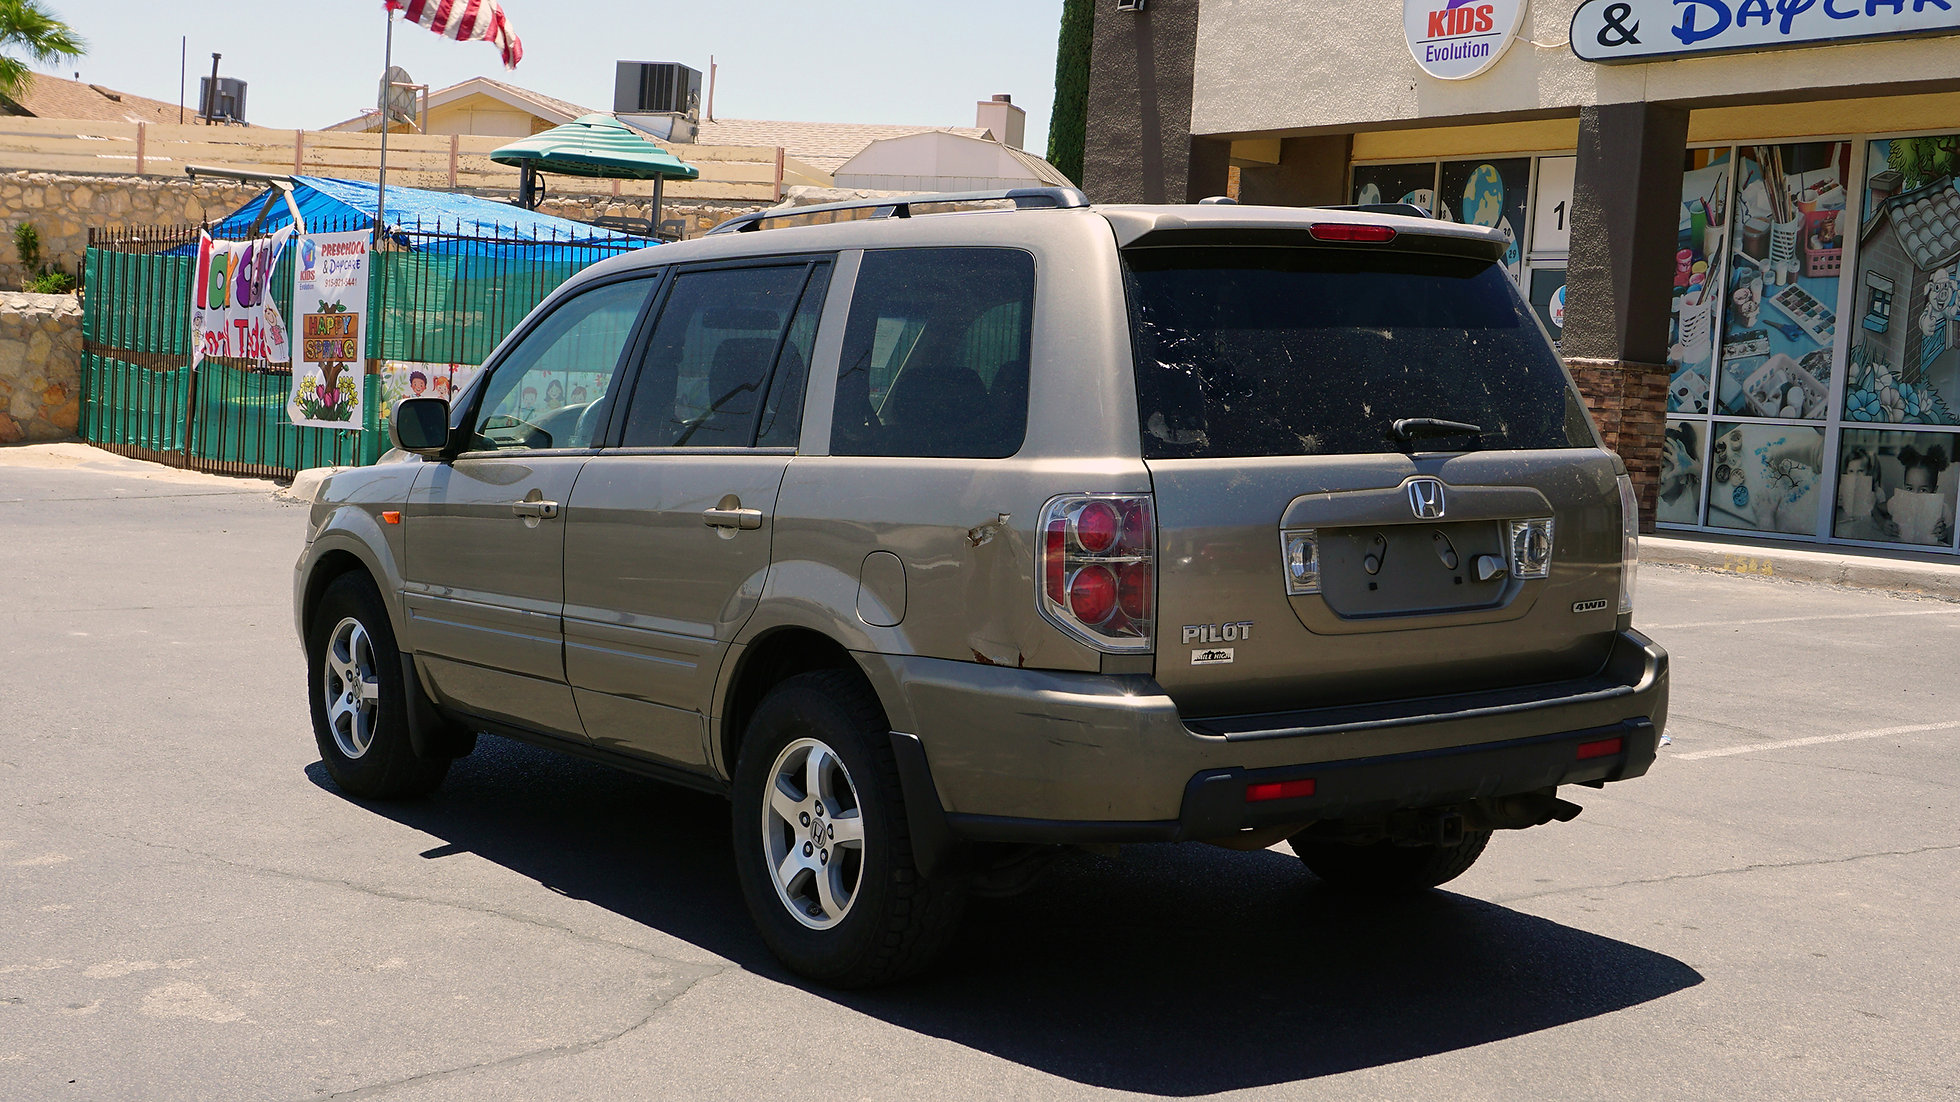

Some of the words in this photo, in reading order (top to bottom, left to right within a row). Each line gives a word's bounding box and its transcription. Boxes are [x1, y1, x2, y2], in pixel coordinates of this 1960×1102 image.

[1427, 4, 1494, 38] KIDS
[1597, 2, 1642, 47] &
[1425, 41, 1489, 62] Evolution
[1553, 200, 1571, 231] 1
[321, 241, 365, 257] PRESCHOOL
[1508, 249, 1516, 258] 29
[300, 270, 315, 281] KIDS
[329, 258, 361, 275] DAYCARE
[309, 315, 352, 335] HAPPY
[306, 339, 354, 359] SPRING
[1575, 600, 1606, 611] 4WD
[1182, 621, 1254, 645] PILOT
